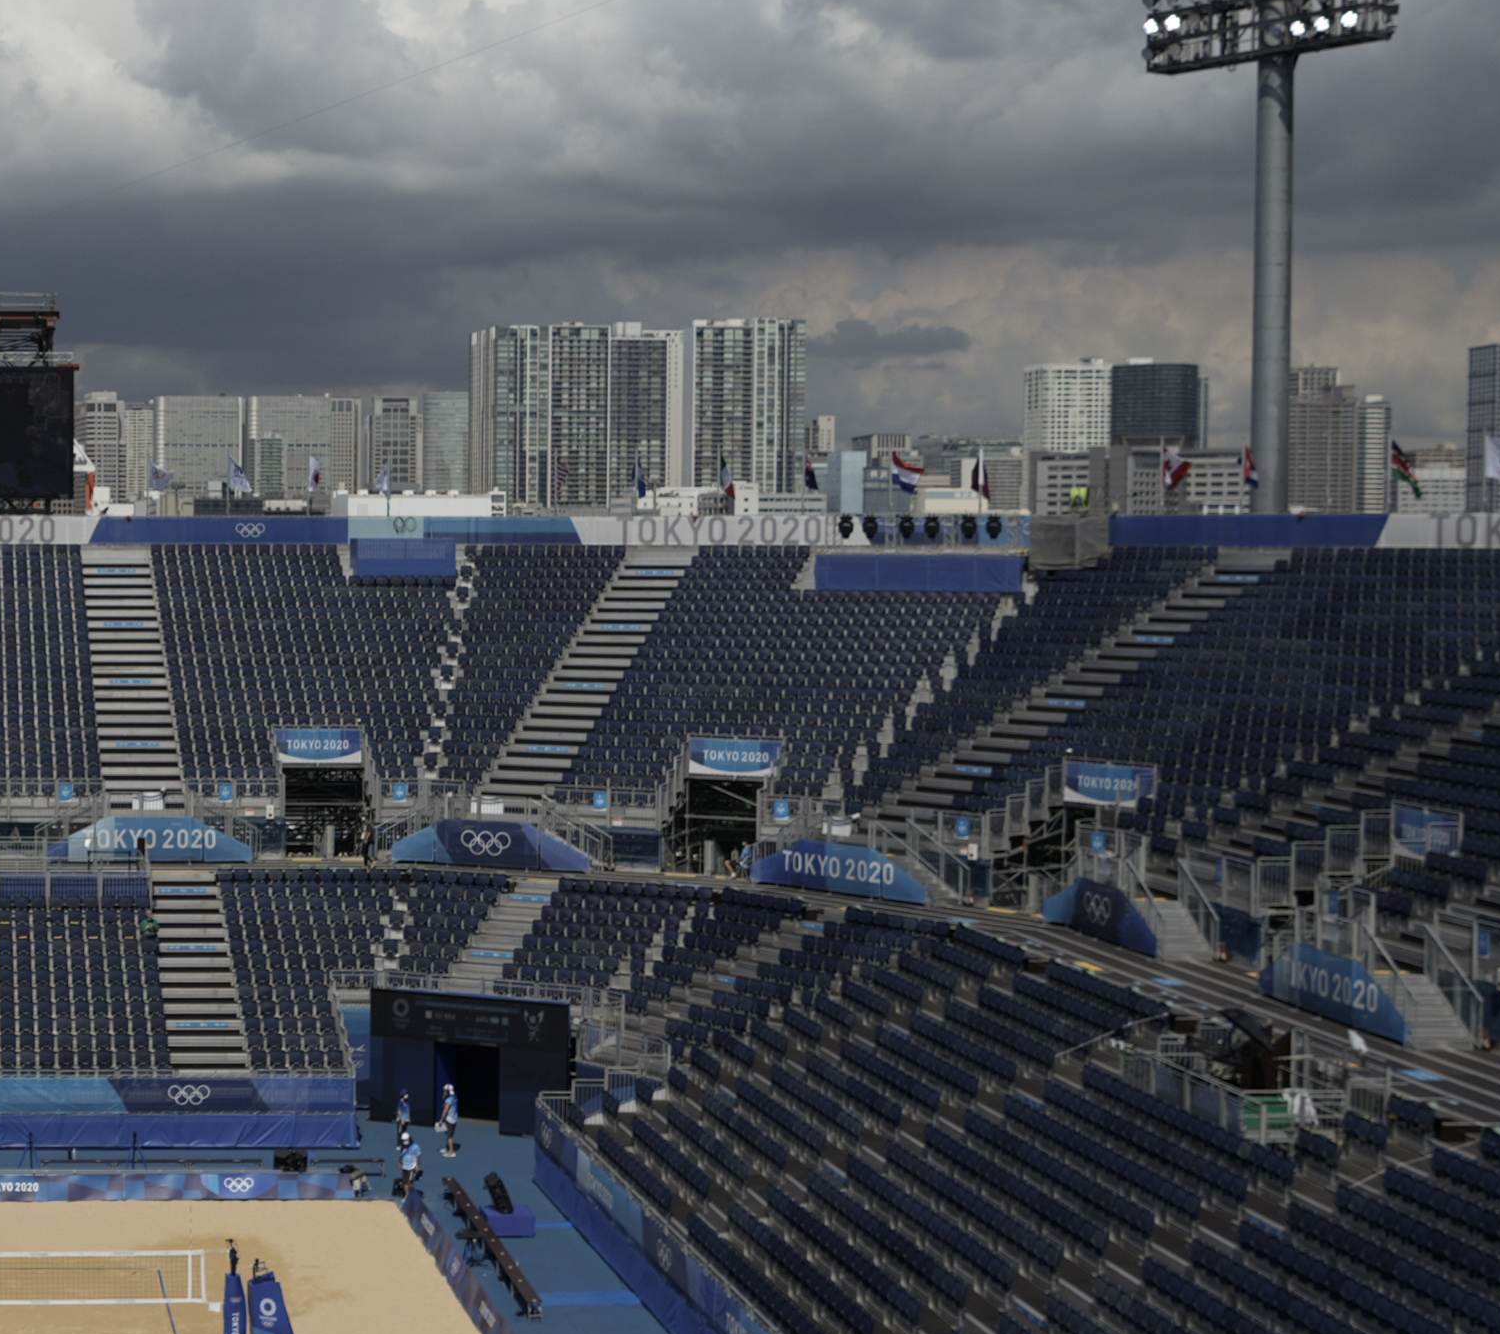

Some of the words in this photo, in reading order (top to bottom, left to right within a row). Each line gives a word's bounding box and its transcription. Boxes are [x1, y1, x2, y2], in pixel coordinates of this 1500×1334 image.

[616, 515, 727, 547] TOKYO
[738, 514, 821, 546] 2020
[287, 739, 321, 750] TOKYO
[323, 739, 350, 750] 2020
[703, 749, 739, 762] TOKYO
[741, 751, 769, 763] 2020
[1077, 775, 1110, 790] TOKYO
[82, 828, 157, 849] TOKYO
[162, 828, 217, 849] 2020
[781, 849, 840, 878] TOKYO
[844, 857, 895, 886] 2020
[1332, 972, 1379, 1013] 2020
[14, 1182, 39, 1192] 2020
